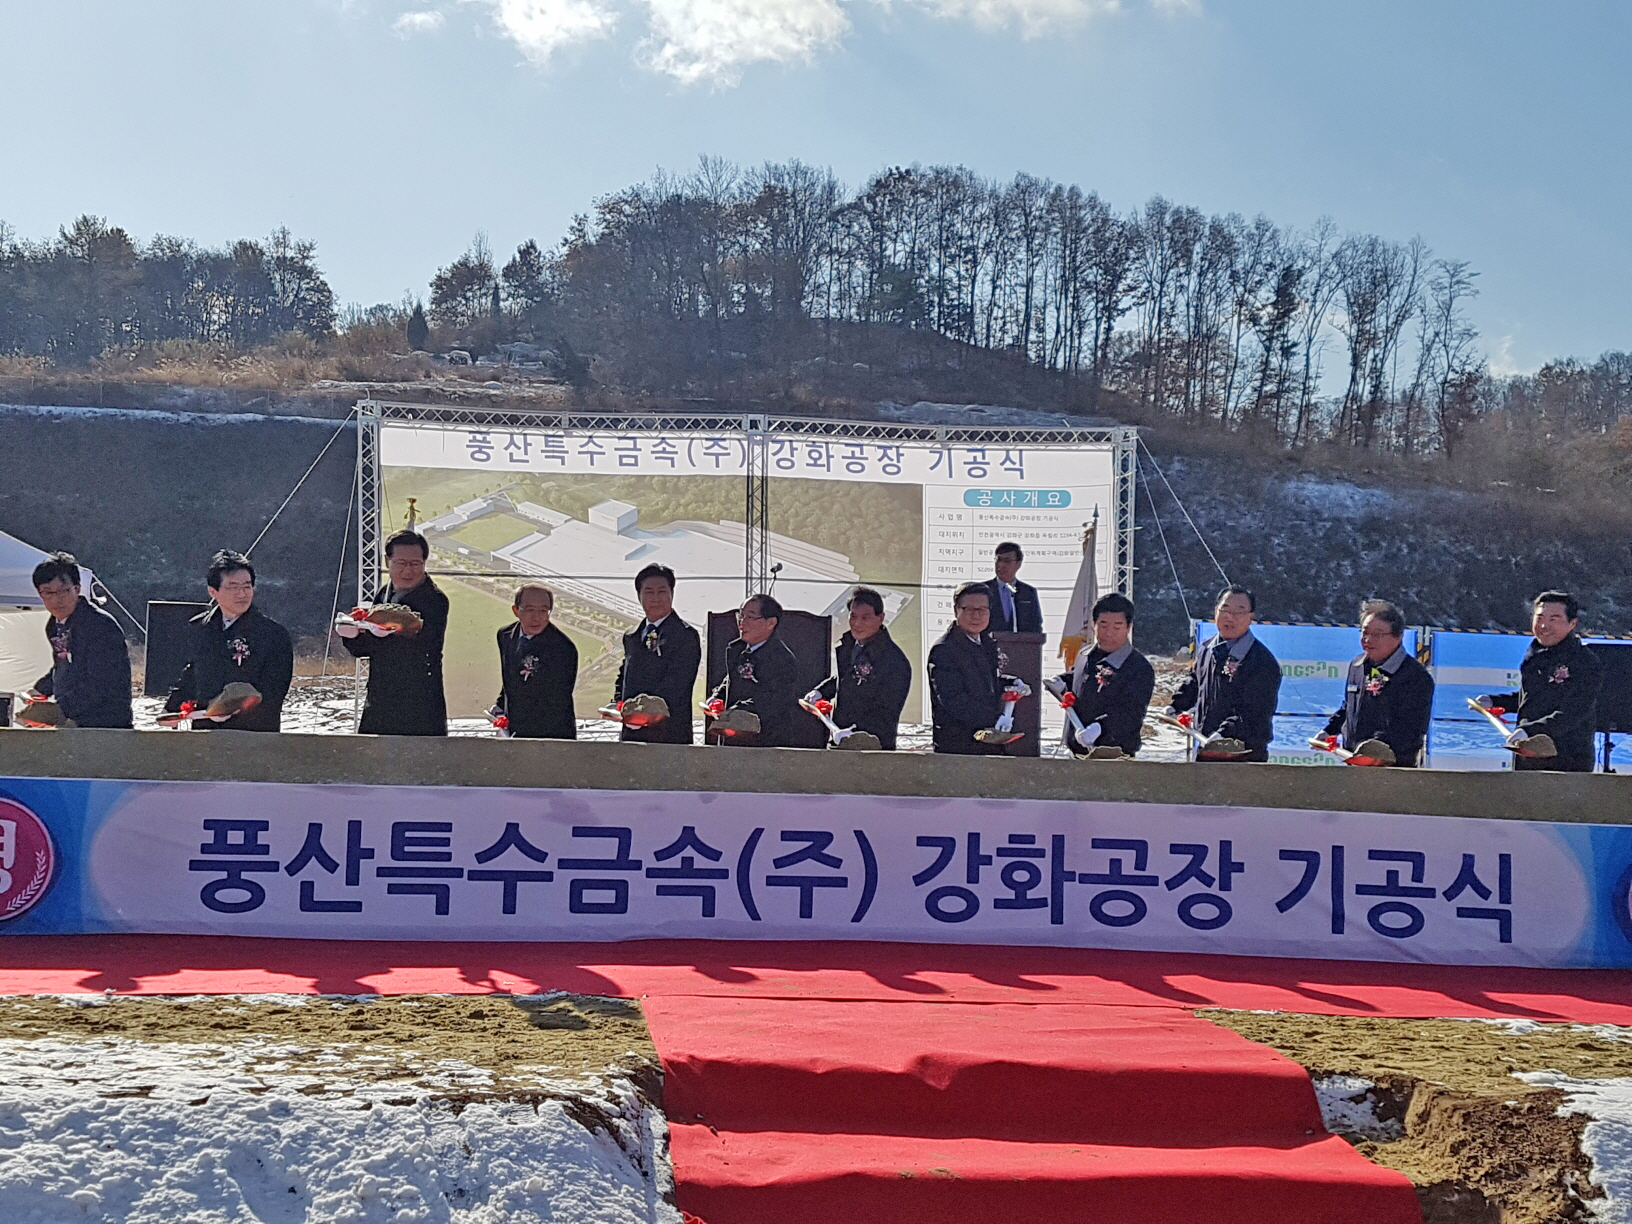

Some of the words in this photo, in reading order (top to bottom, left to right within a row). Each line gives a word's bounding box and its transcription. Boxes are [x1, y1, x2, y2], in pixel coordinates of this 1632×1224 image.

[465, 431, 747, 469] 풍산특수금속(주)
[771, 439, 905, 476] 강화공장
[929, 449, 1026, 480] 기공식
[188, 817, 879, 924] 풍산특수금속(주)
[911, 832, 1246, 932] 강화공장
[1275, 845, 1515, 945] 기공식
